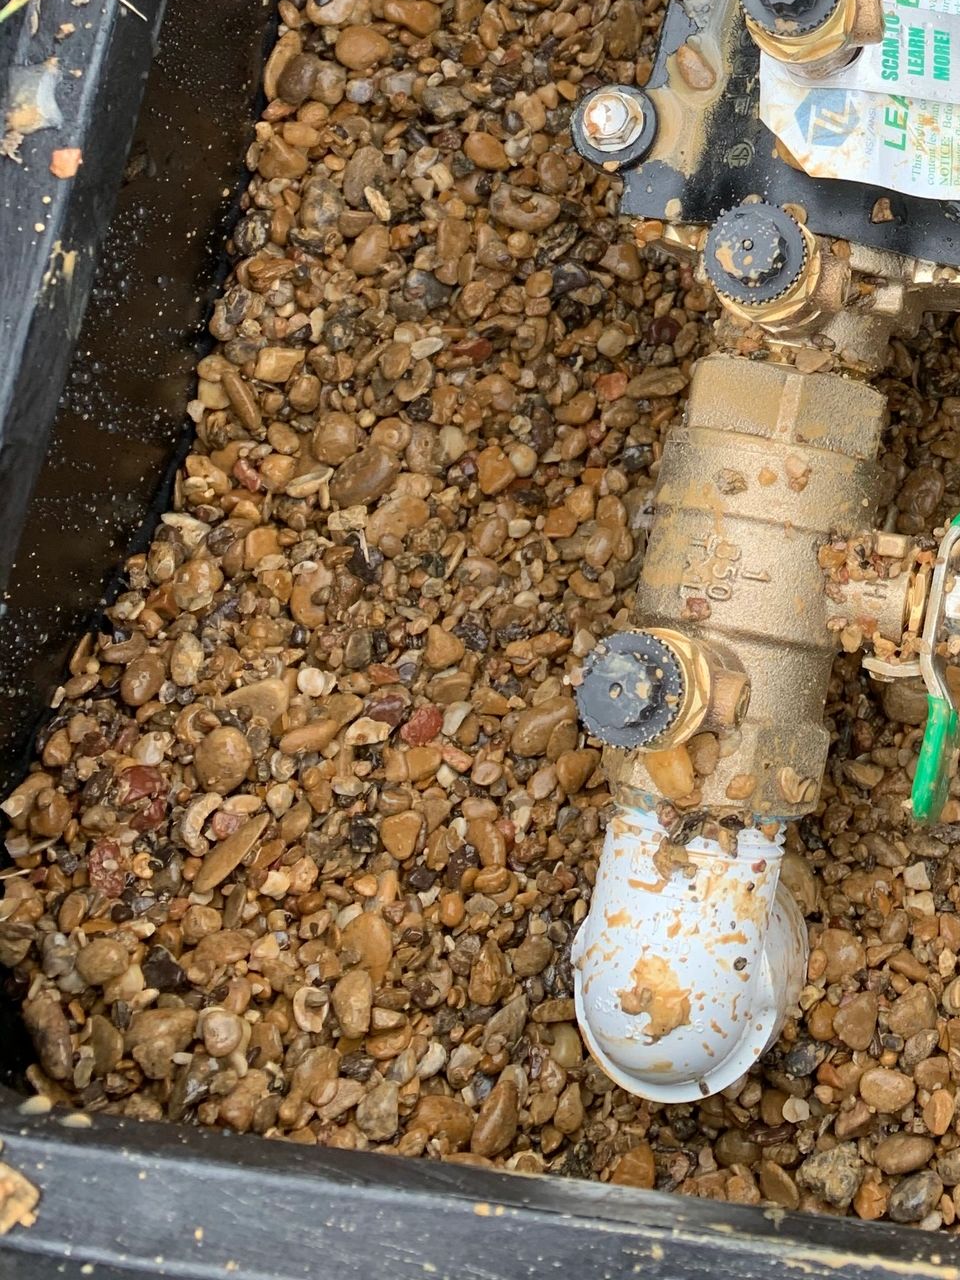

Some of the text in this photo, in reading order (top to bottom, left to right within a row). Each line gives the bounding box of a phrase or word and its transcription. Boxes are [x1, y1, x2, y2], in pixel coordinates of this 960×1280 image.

[881, 14, 900, 82] SCAN TO
[907, 26, 925, 76] LEARN
[932, 30, 951, 82] MORE!
[884, 94, 909, 152] LEA
[939, 136, 953, 186] NOTICE:
